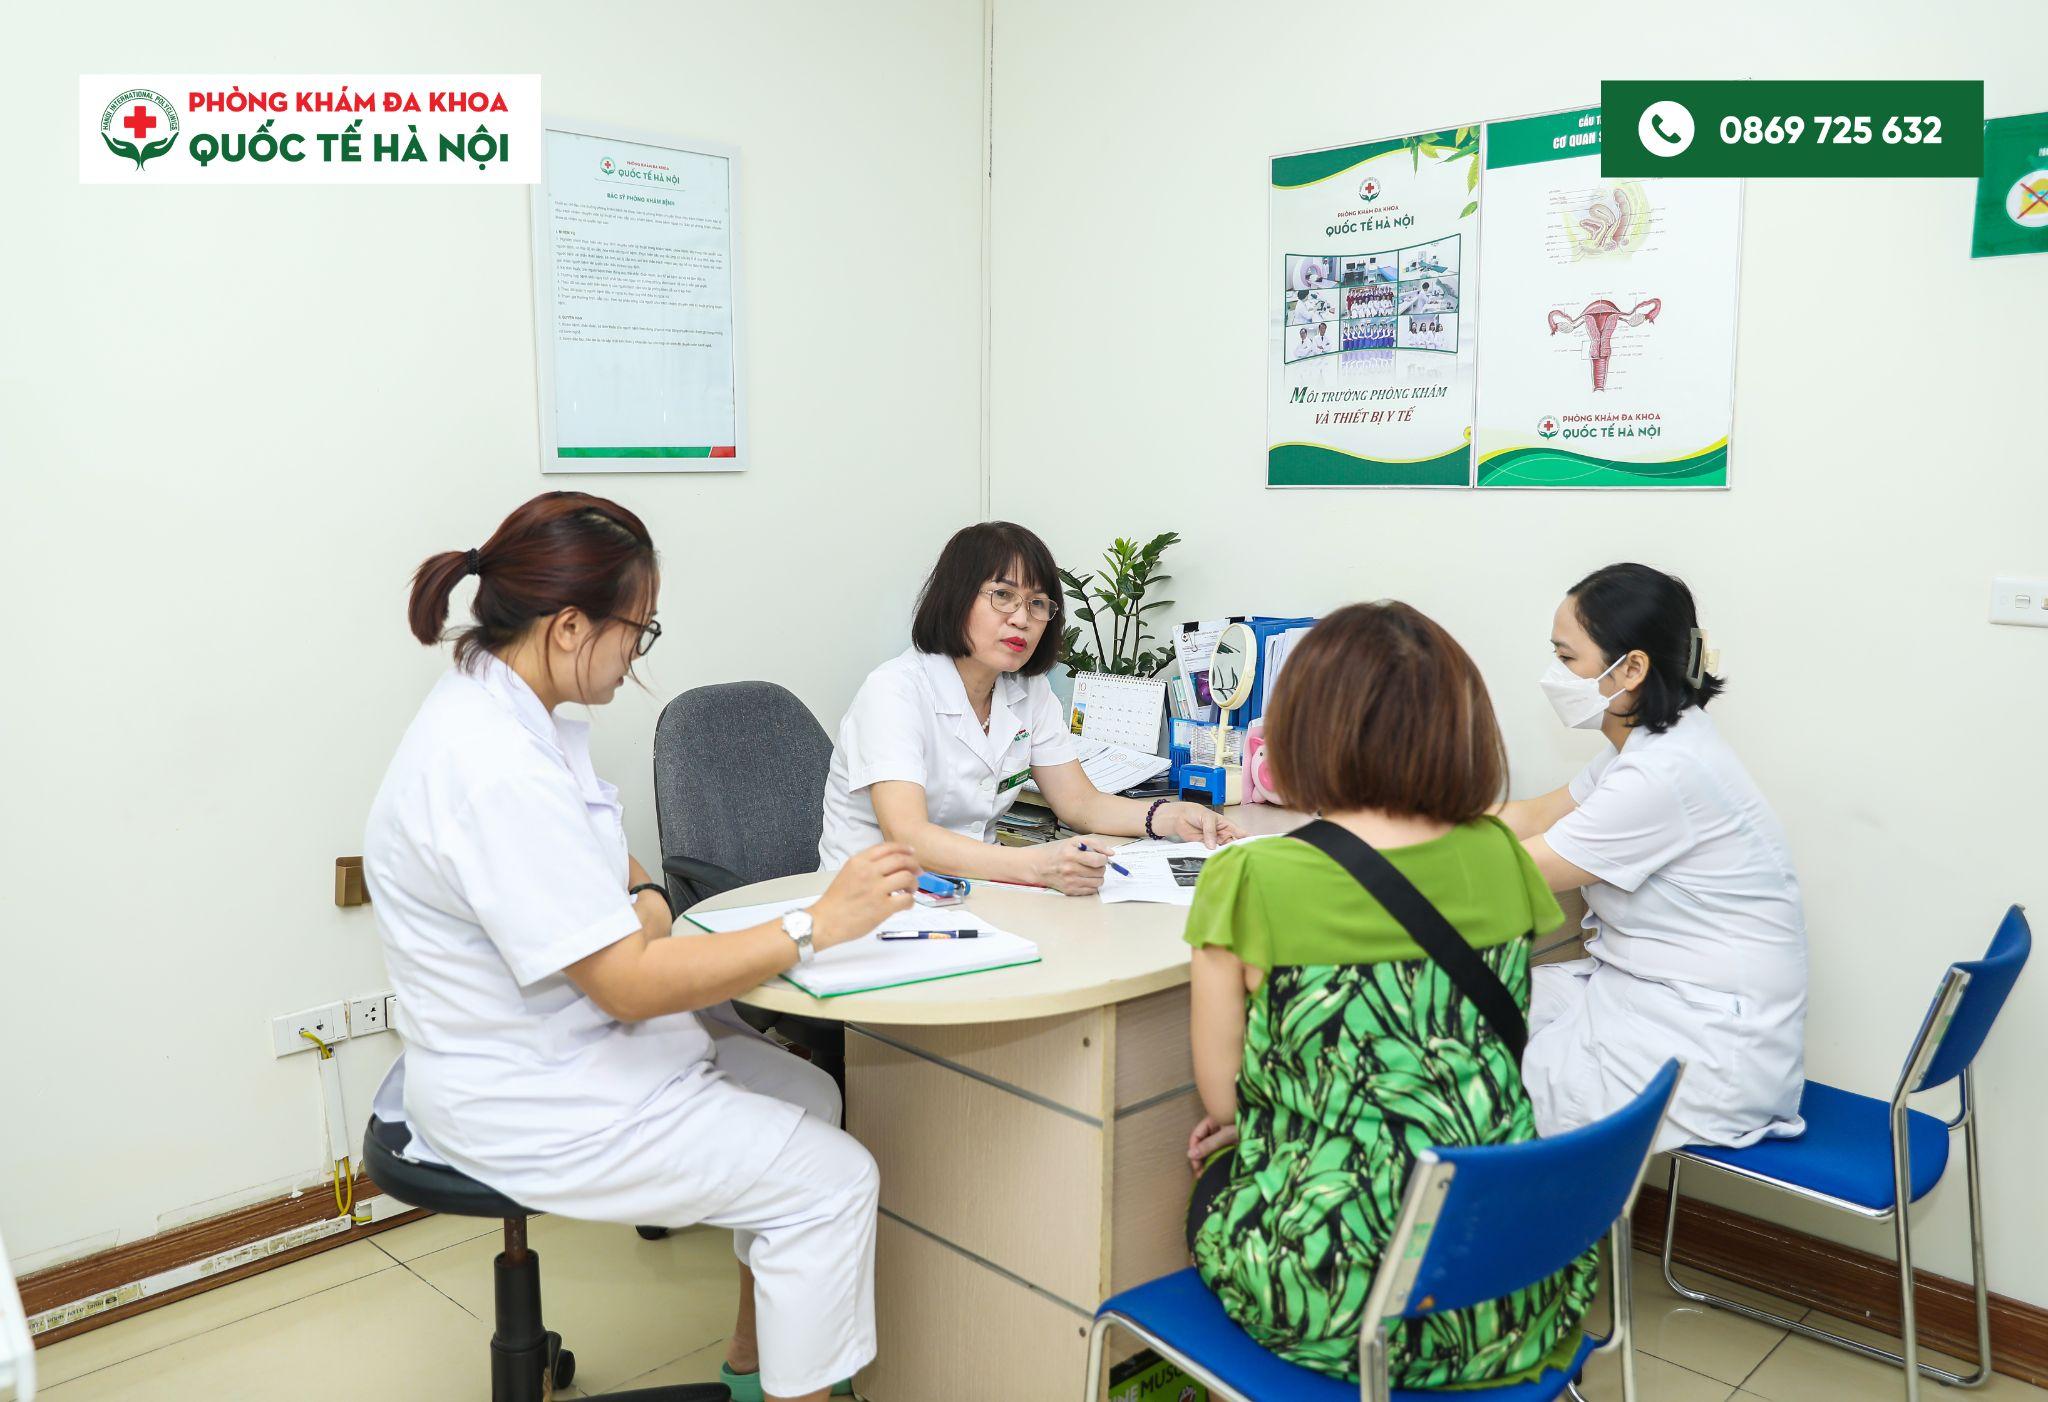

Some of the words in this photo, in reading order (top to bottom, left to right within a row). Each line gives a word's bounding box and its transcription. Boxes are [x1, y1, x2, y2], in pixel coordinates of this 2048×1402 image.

[1553, 135, 1567, 149] CƠ
[1569, 132, 1596, 147] QUAN
[618, 167, 641, 179] QUỐC
[643, 170, 652, 180] TẾ
[653, 173, 664, 182] HÀ
[666, 174, 680, 186] NỘI
[1337, 210, 1357, 218] PHÒNG
[1357, 208, 1374, 216] KHÁM
[1325, 219, 1357, 237] QUỐC
[1360, 216, 1373, 231] TẾ
[1375, 216, 1390, 230] HÀ
[1393, 213, 1414, 229] NỘI
[1289, 386, 1319, 404] MÔI
[1321, 388, 1369, 403] TRƯỜNG
[1369, 386, 1410, 401] PHÒNG
[1411, 384, 1448, 399] KHÁM
[1314, 410, 1331, 425] VÀ
[1332, 407, 1370, 424] THIẾT
[1370, 411, 1384, 425] BỊ
[1385, 410, 1395, 422] Y
[1397, 406, 1416, 422] TẾ
[1562, 414, 1593, 423] PHÒNG
[1594, 412, 1619, 422] KHÁM
[1621, 413, 1634, 421] ĐA
[1635, 413, 1661, 421] KHOA
[1563, 424, 1597, 439] QUỐC
[1600, 423, 1616, 437] TẾ
[1618, 425, 1635, 437] HÀ
[1638, 424, 1661, 439] NỘI
